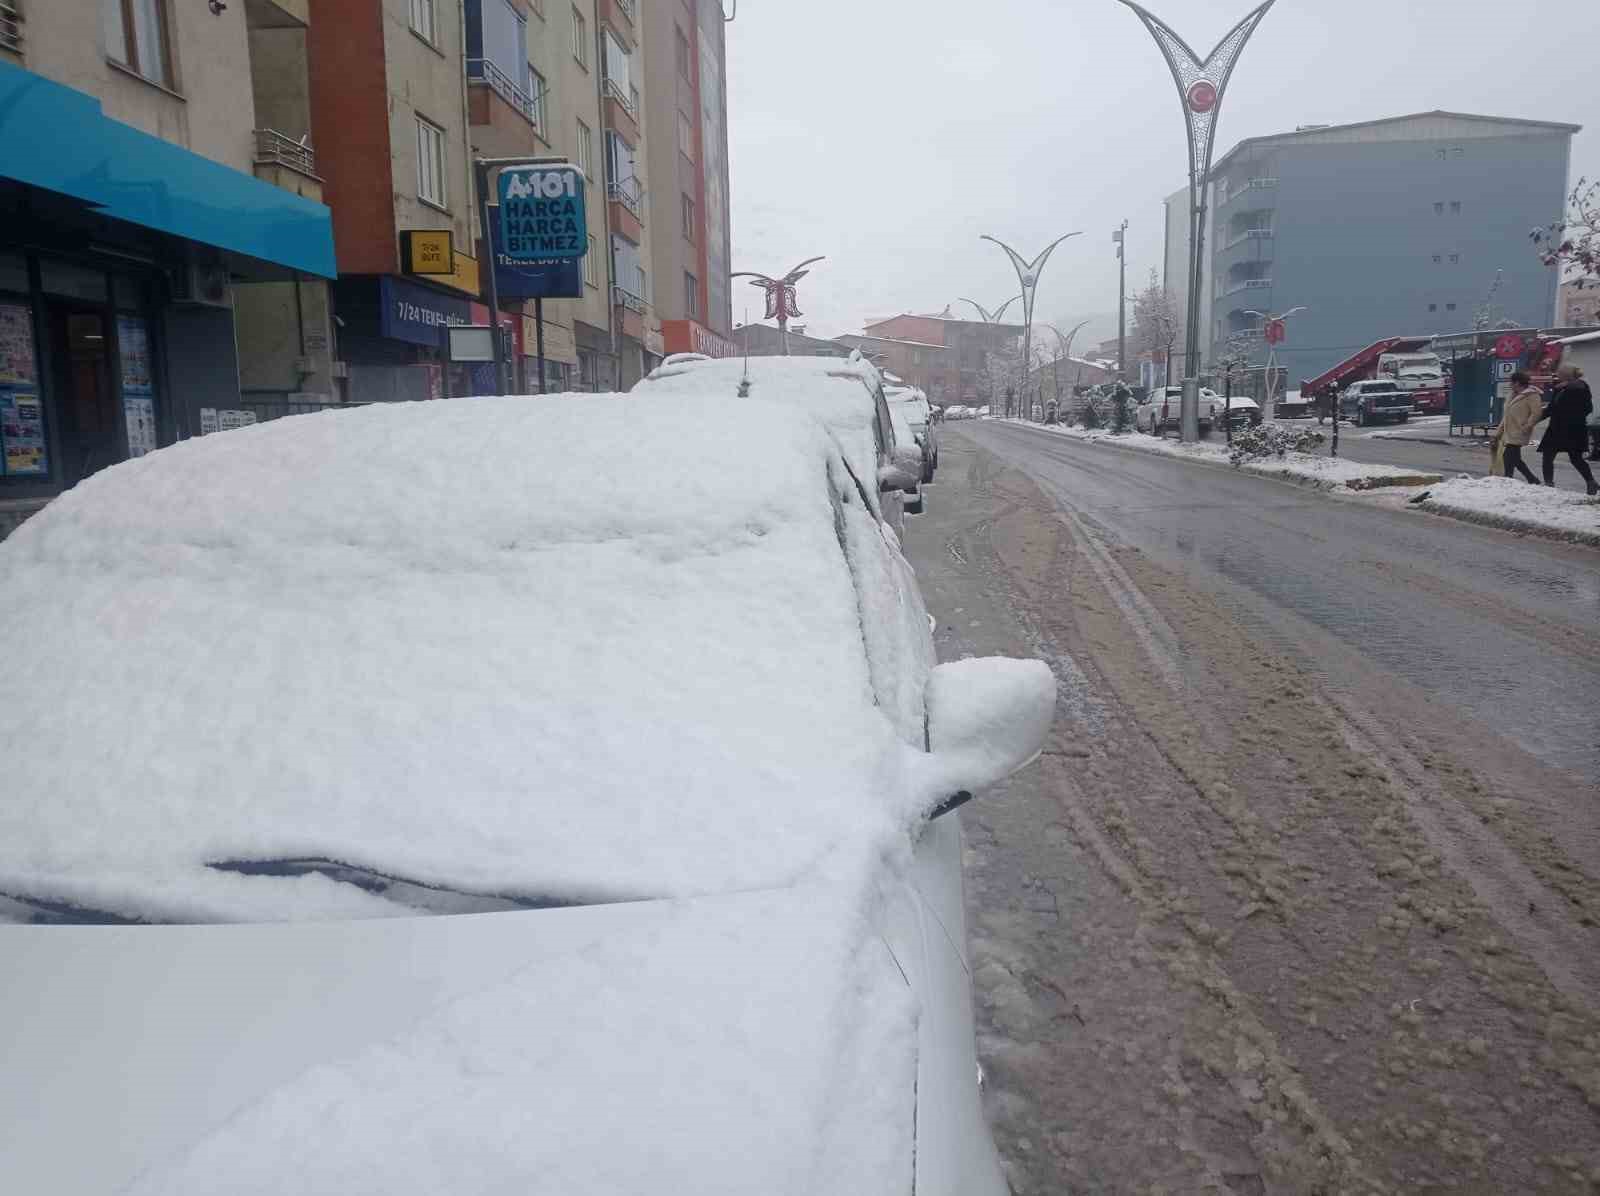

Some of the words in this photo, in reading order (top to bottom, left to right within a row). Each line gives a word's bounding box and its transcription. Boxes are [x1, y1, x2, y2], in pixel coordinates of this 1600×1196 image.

[505, 200, 577, 217] HARCA
[507, 218, 577, 235] HARCA
[398, 302, 420, 321] 7/24
